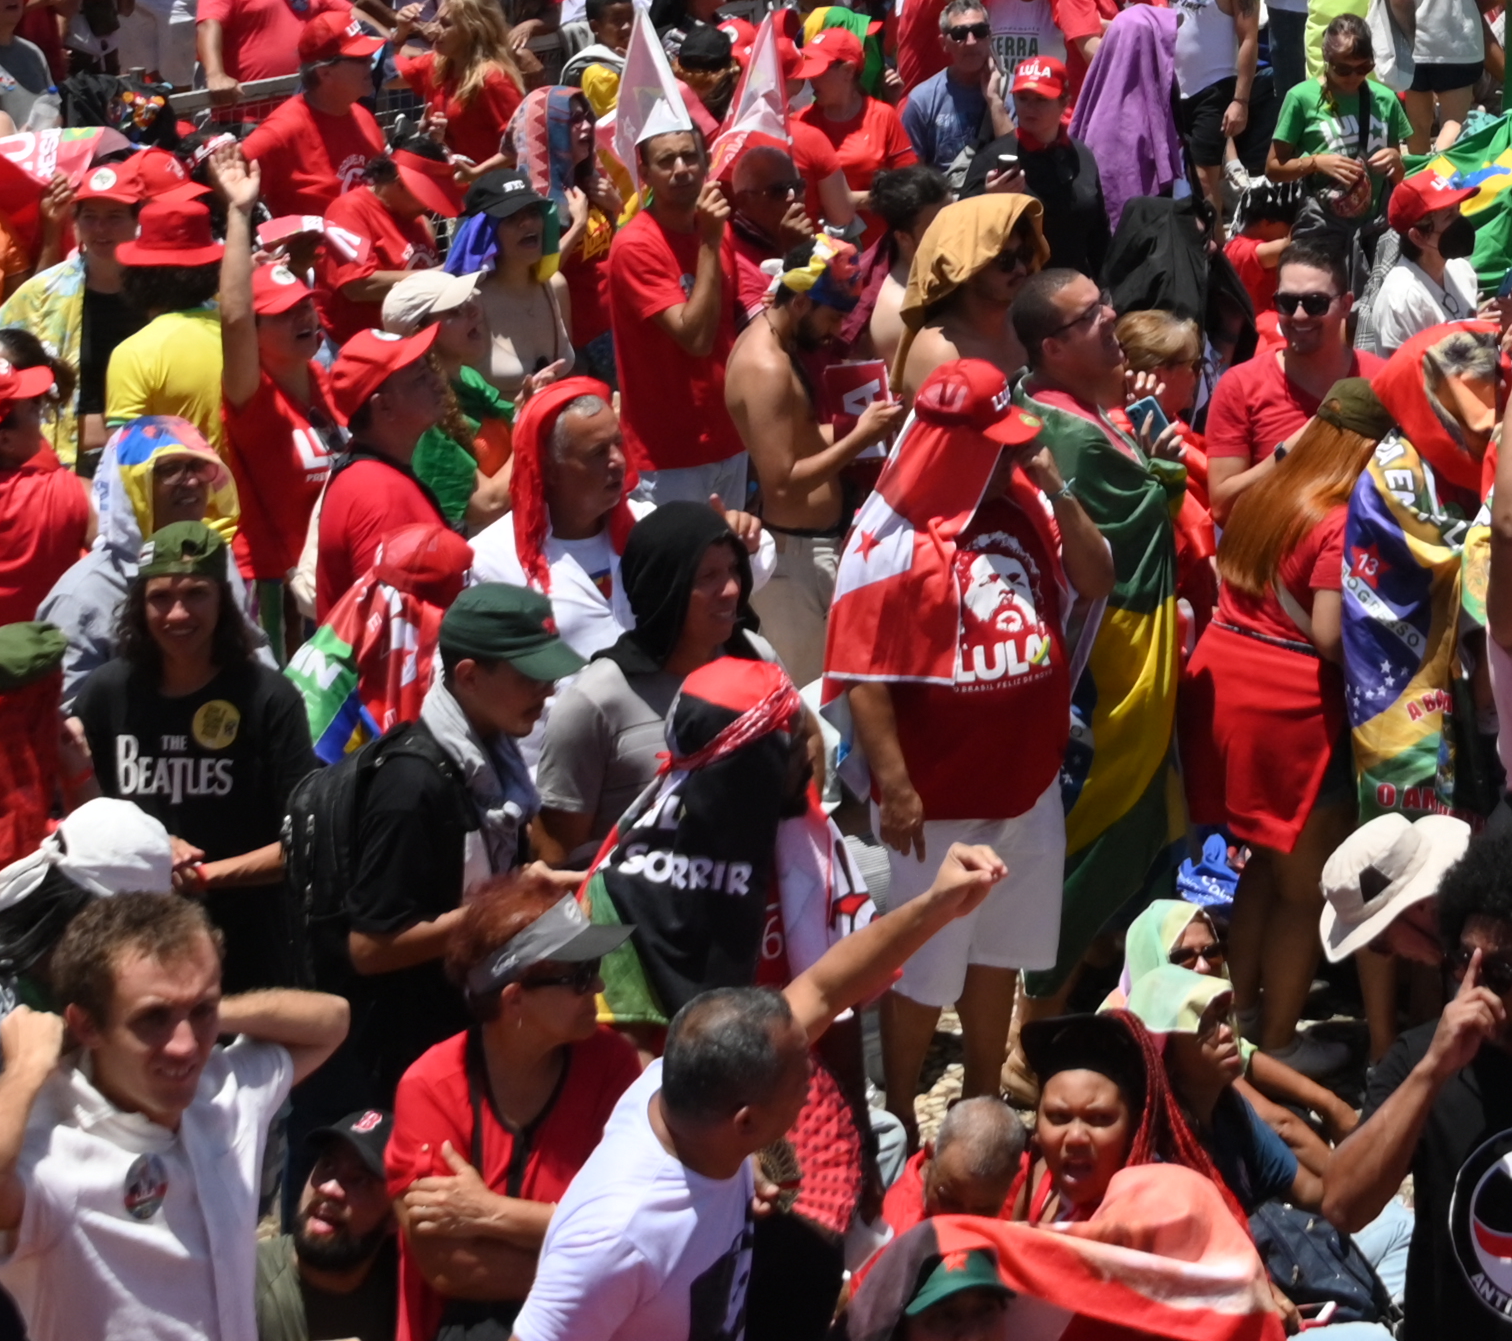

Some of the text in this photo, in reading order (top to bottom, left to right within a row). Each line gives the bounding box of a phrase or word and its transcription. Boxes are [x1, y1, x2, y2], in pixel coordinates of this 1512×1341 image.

[1019, 64, 1052, 79] LULA
[1356, 549, 1380, 579] 13
[956, 633, 1052, 684] LULA
[961, 683, 995, 693] BRASIL
[161, 734, 188, 752] THE
[115, 733, 236, 806] BEATLES
[617, 842, 754, 896] SORRIR
